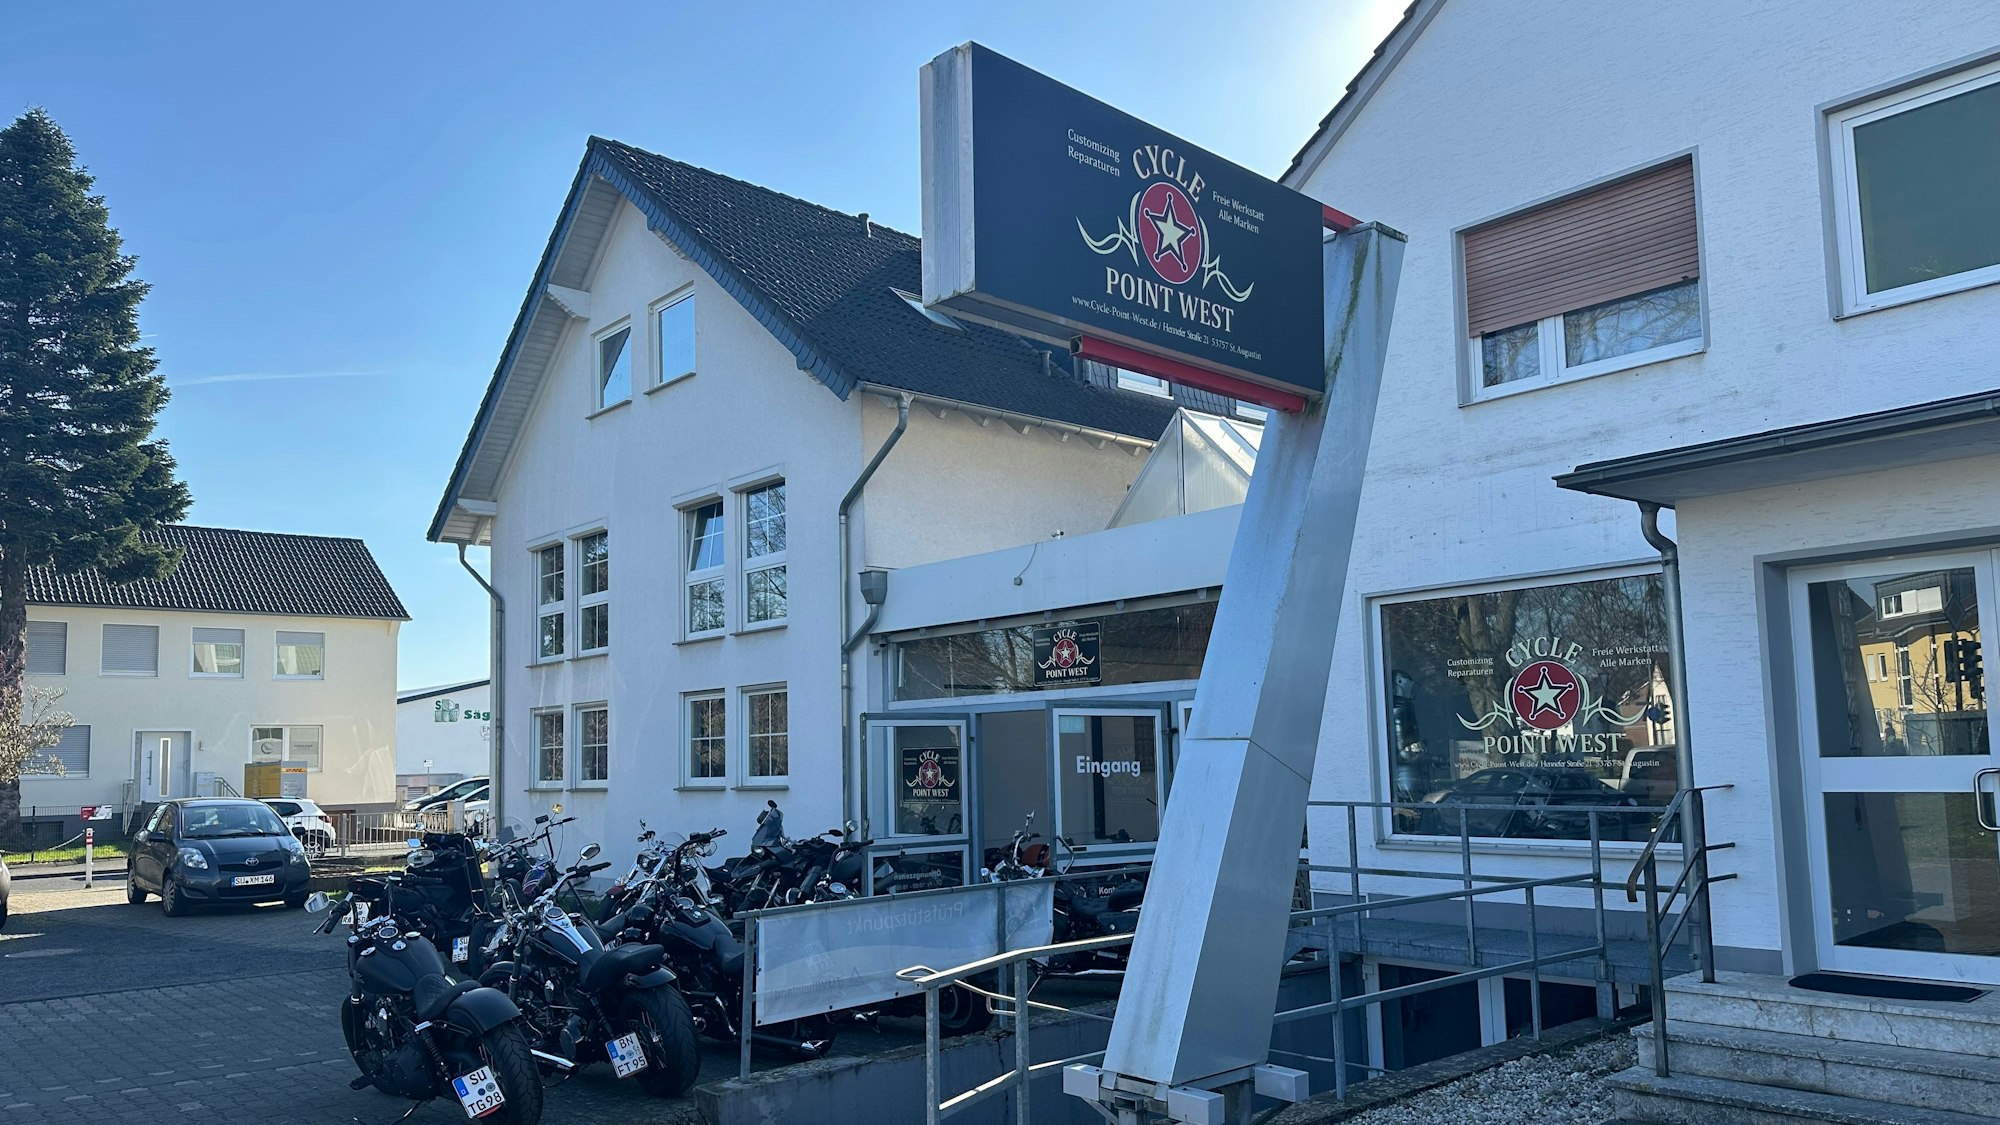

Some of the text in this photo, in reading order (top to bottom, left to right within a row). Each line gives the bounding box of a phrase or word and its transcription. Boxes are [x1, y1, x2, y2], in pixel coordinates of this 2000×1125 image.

[1067, 128, 1120, 163] Customizing
[1067, 146, 1120, 177] Reparaturen
[1132, 145, 1206, 202] CYCLE
[1212, 191, 1265, 222] Freie Werkstatt
[1218, 209, 1259, 234] Alle Marken
[1105, 266, 1235, 333] POINT WEST
[1071, 296, 1158, 329] www.Cycle-Point-West.de
[1211, 338, 1229, 350] 53757
[1053, 629, 1077, 643] CYCLE
[1505, 636, 1583, 668] CYCLE
[1592, 644, 1659, 657] Freie Werkstatt
[1447, 656, 1494, 667] Customizing
[1600, 656, 1652, 668] Alle Marken
[1046, 666, 1088, 678] POINT WEST
[1447, 667, 1494, 679] Reparaturen
[1483, 733, 1621, 755] POINT WEST
[919, 750, 940, 763] CYCLE
[1076, 755, 1141, 778] Eingang
[912, 789, 949, 797] POINT WEST
[619, 1036, 634, 1049] BN
[469, 1070, 487, 1085] SU
